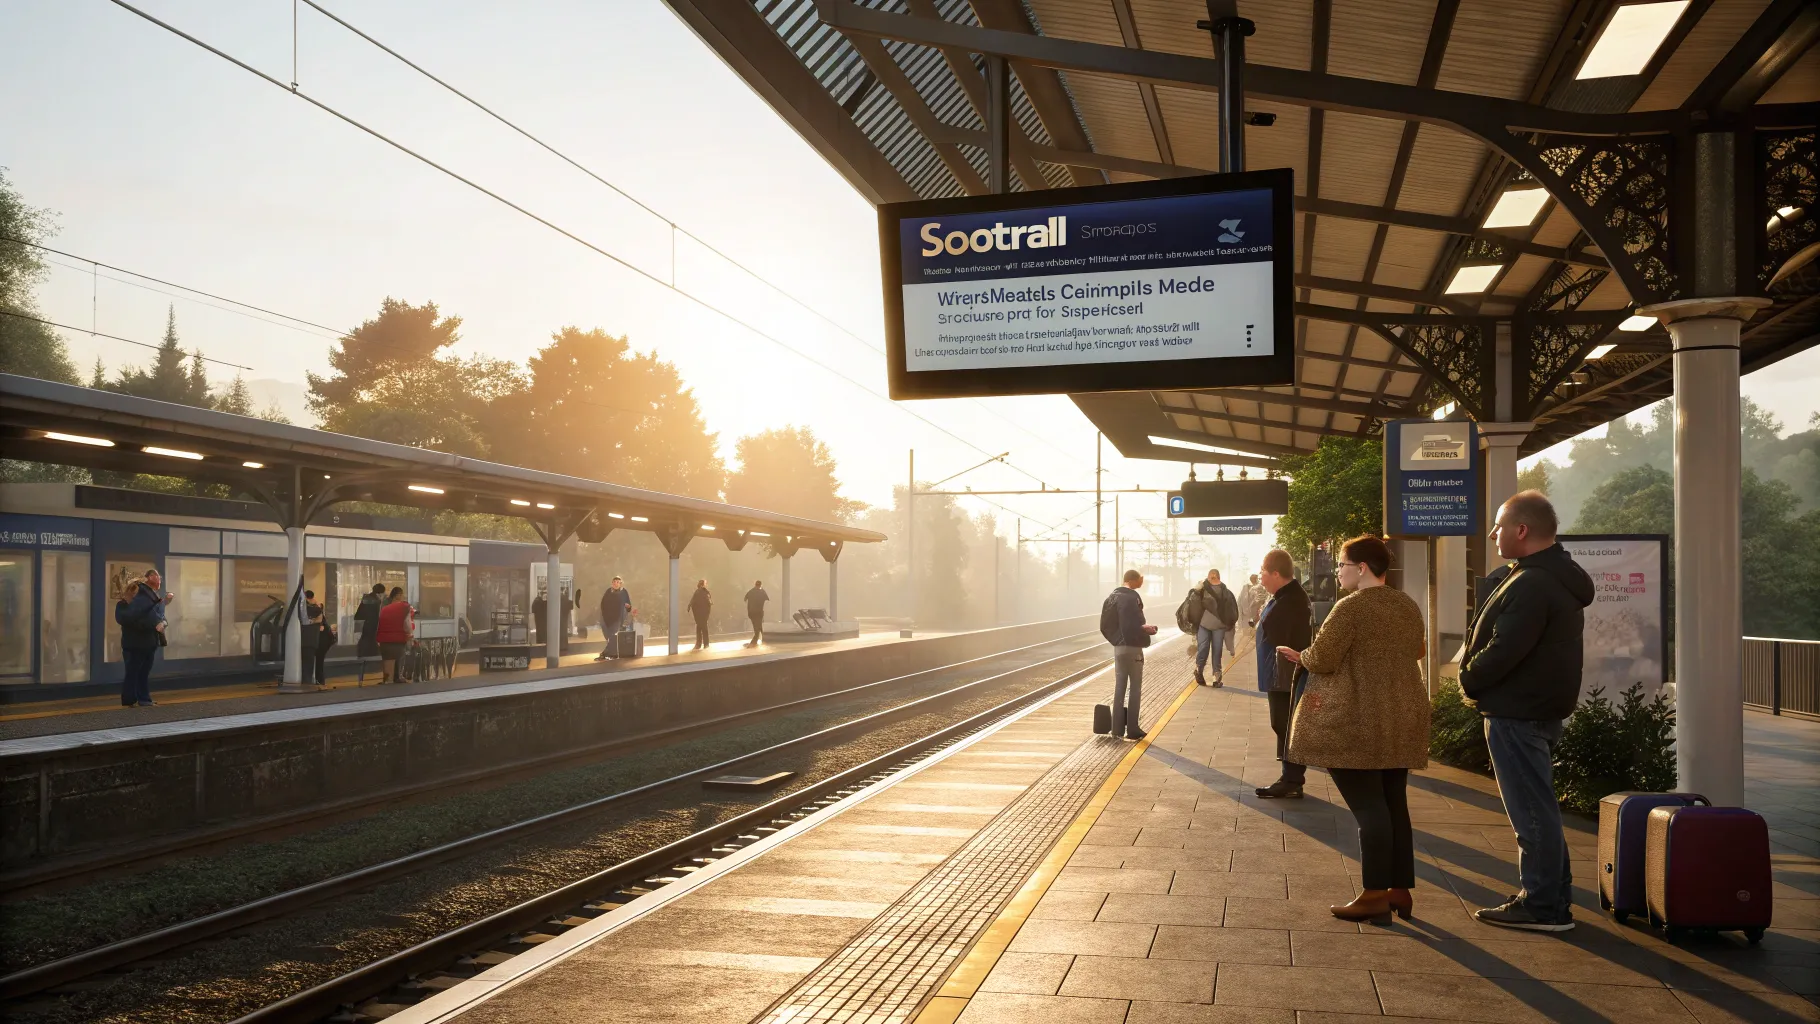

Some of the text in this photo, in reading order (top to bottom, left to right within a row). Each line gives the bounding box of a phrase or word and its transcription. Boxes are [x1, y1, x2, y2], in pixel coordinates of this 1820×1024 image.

[920, 215, 1067, 257] Sootrall
[1159, 276, 1215, 294] Mede
[1036, 306, 1056, 318] for
